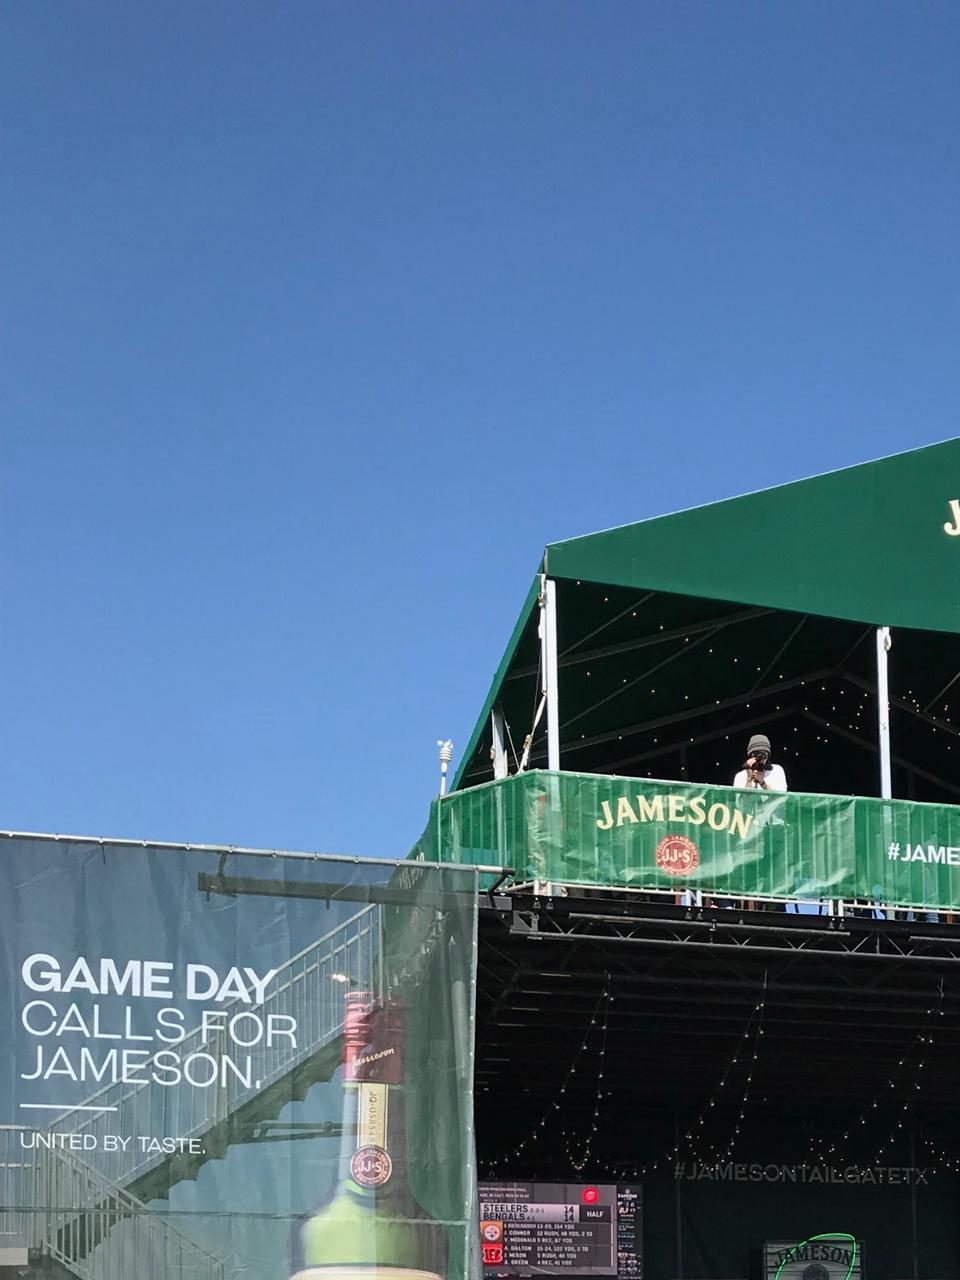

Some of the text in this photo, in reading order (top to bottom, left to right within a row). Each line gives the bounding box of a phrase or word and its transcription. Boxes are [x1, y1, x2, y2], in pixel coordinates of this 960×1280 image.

[596, 795, 753, 840] JAMESON
[21, 953, 278, 1005] GAME DAY
[21, 1000, 298, 1048] CALLS FOR
[20, 1045, 261, 1090] JAMESON.
[20, 1133, 206, 1154] UNITED BY TASTE.
[483, 1204, 529, 1213] STEELERS
[564, 1205, 575, 1213] 14
[483, 1212, 525, 1221] BENGALS
[586, 1210, 604, 1218] HALF
